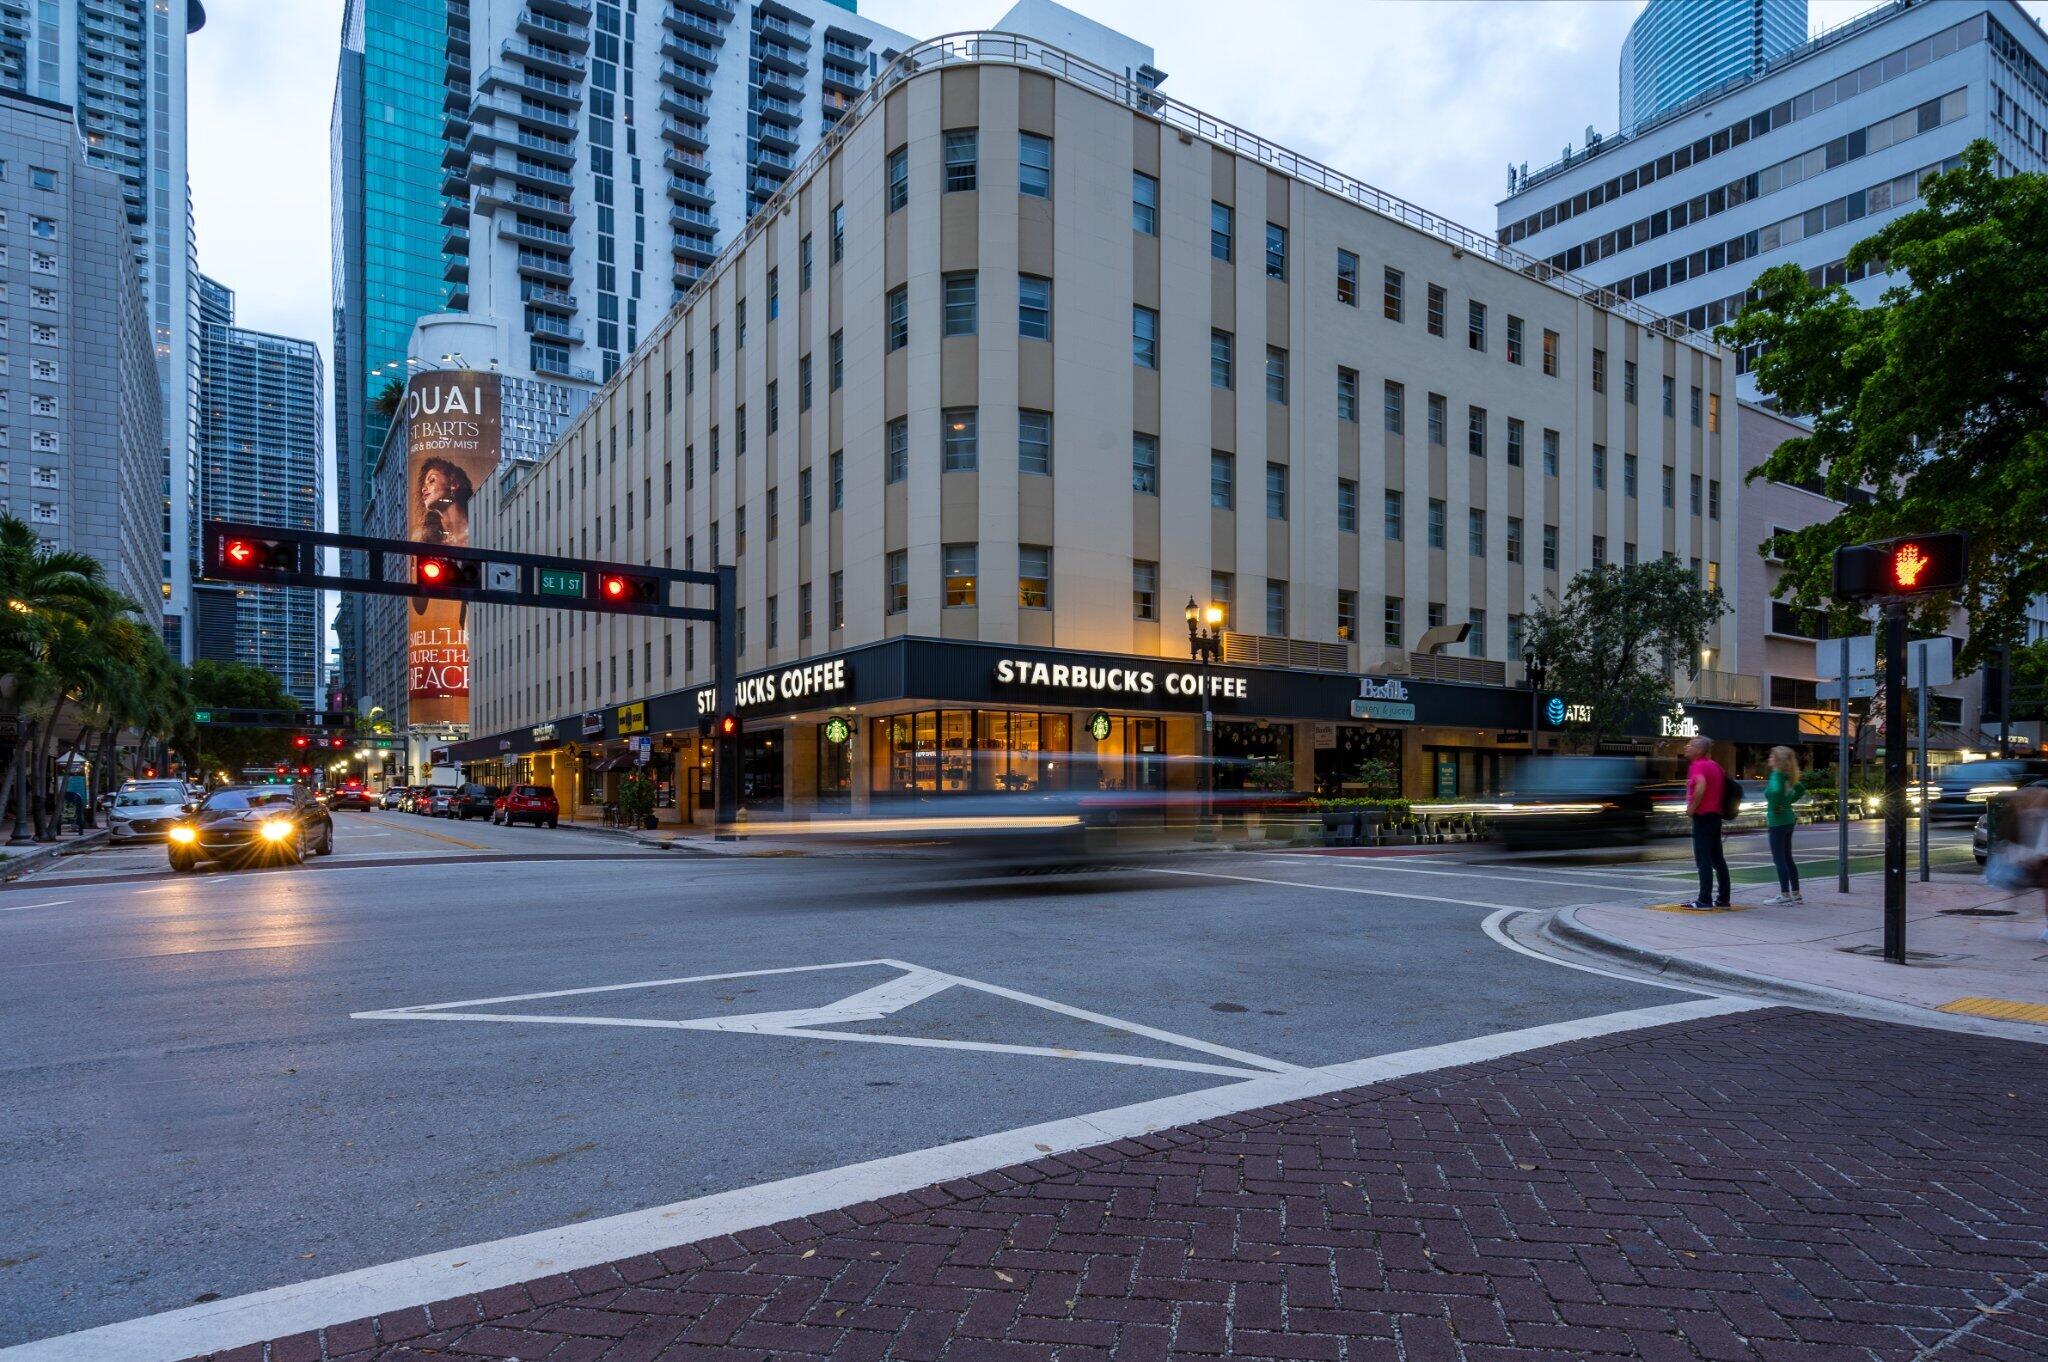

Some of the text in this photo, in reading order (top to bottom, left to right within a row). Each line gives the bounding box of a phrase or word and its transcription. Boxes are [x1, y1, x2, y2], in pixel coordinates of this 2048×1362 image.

[422, 421, 480, 438] BARTS
[425, 440, 452, 450] BODY
[453, 440, 479, 450] MIST
[543, 577, 580, 590] SE 1 ST
[443, 649, 470, 663] TH
[697, 659, 845, 715] STUCKS COFFEE
[997, 659, 1248, 699] STARBUCKS COFFEE
[1358, 678, 1409, 701] Bastille
[1565, 704, 1594, 722] AT&T
